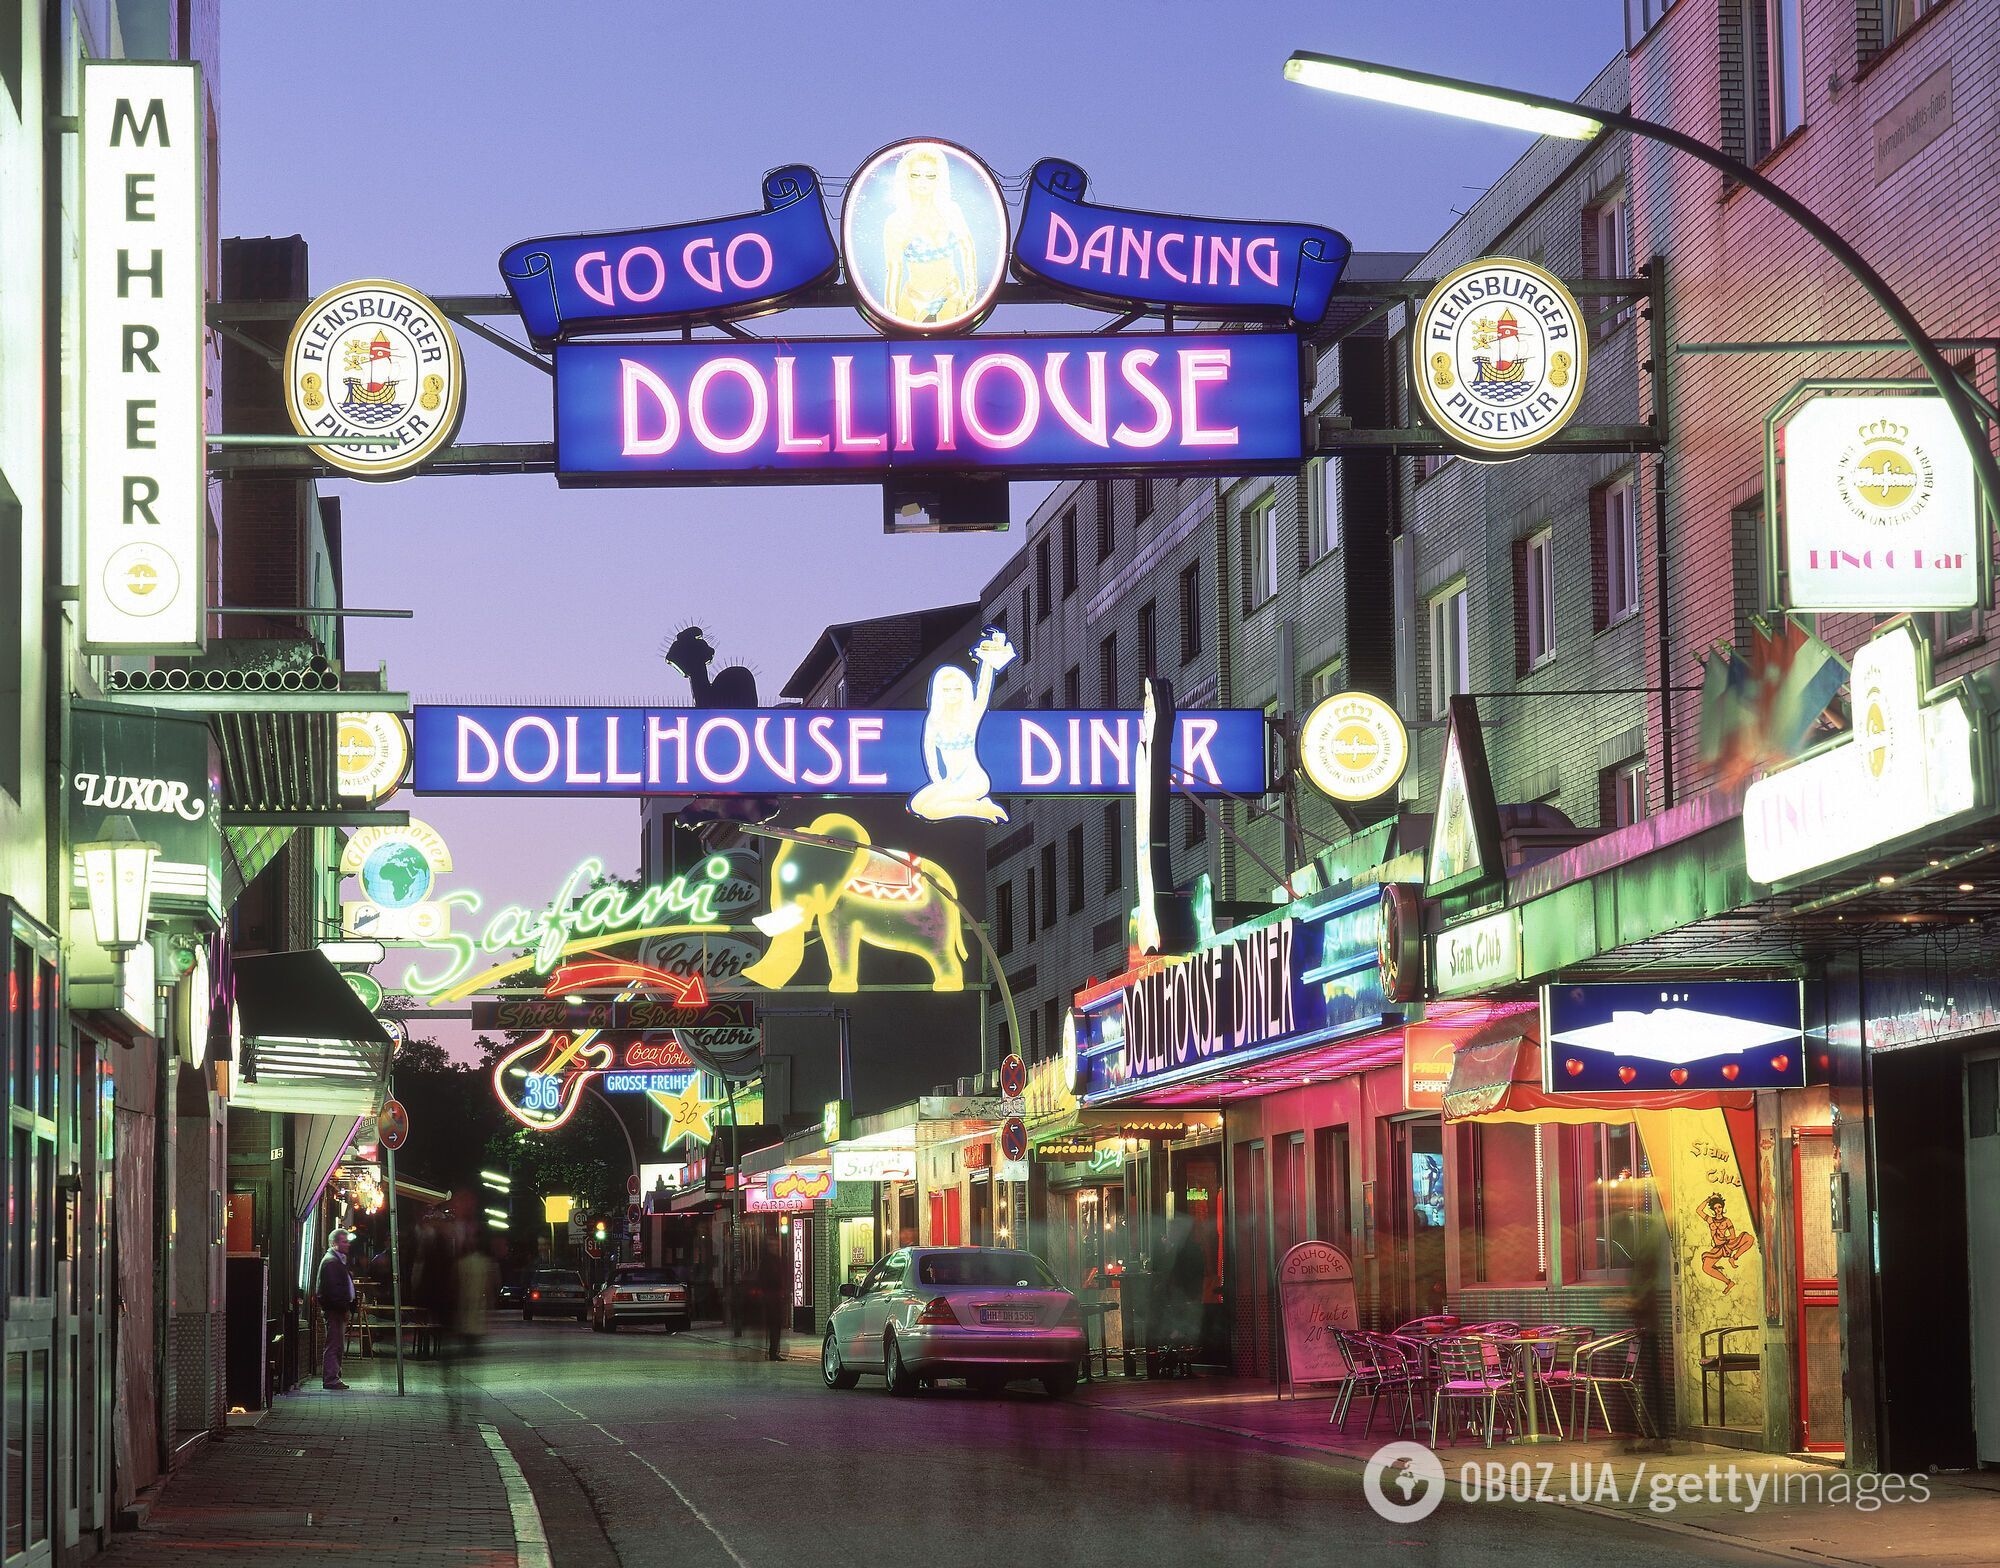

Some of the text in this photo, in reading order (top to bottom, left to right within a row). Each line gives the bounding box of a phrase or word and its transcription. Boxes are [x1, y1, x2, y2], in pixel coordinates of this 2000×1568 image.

[1047, 211, 1280, 287] DANCING
[575, 232, 772, 307] GO GO
[109, 98, 171, 525] MEHRER
[1432, 276, 1569, 341] FLENSBURGER
[303, 298, 442, 363] FLENSBURGER
[620, 348, 1240, 457] DOLLHOUSE
[1446, 391, 1559, 432] PILSENER
[457, 715, 1223, 787] DOLLHOUSE DINR
[74, 773, 206, 821] LUXOR
[404, 856, 731, 994] Safari
[656, 943, 756, 978] Colibri
[1450, 927, 1501, 976] Siam Club
[496, 1001, 567, 1028] Spiel
[587, 1005, 606, 1028] &
[1122, 917, 1296, 1079] DOLLHOUSE DINER
[1661, 992, 1689, 1002] Bar
[525, 1076, 560, 1110] 36
[607, 1076, 648, 1091] GROSSE
[674, 1101, 699, 1125] 36
[271, 1149, 283, 1160] 15
[1039, 1145, 1093, 1154] POPCORN
[1691, 1139, 1730, 1163] Siam
[752, 1200, 803, 1210] GARDEN
[1287, 1249, 1344, 1275] DOLLHOUSE
[1301, 1264, 1331, 1275] DINER
